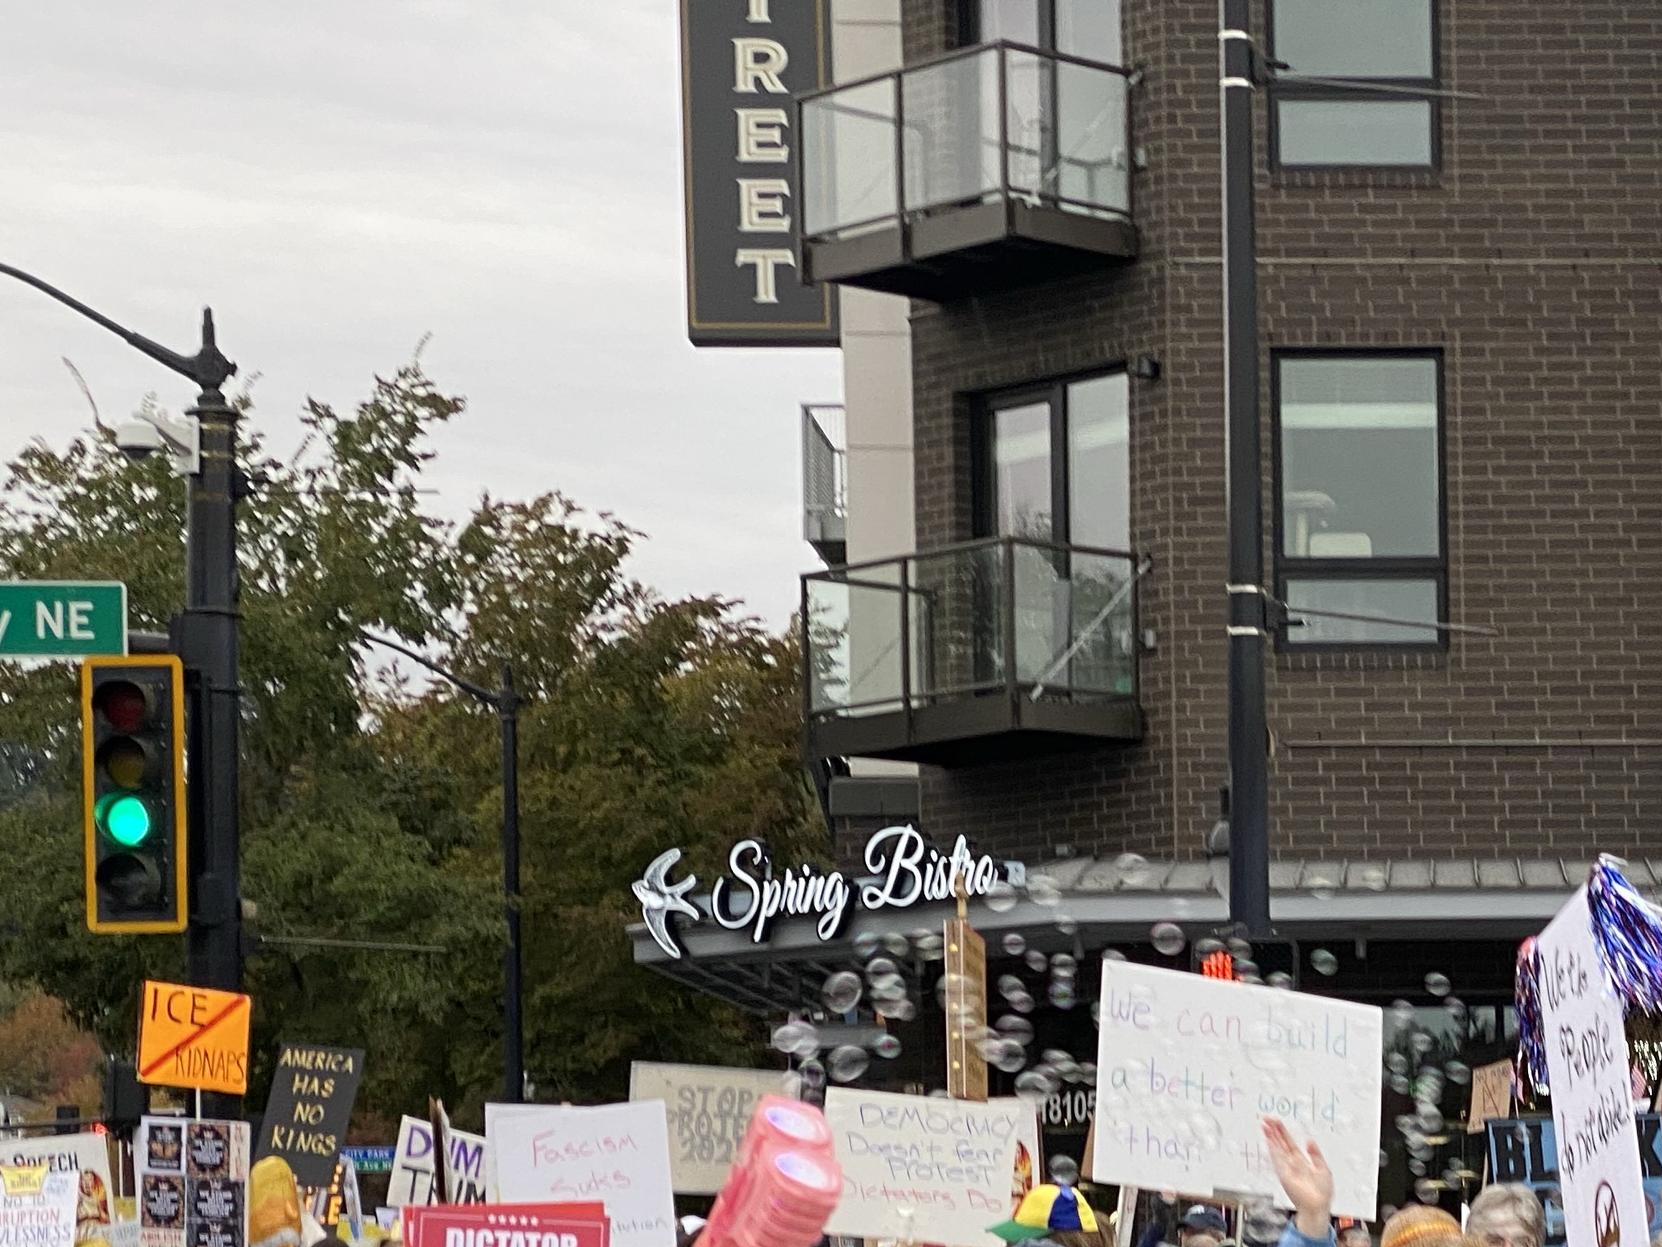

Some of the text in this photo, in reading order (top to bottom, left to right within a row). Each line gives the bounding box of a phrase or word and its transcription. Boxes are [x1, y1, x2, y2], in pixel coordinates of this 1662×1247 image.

[36, 600, 95, 640] NE
[712, 824, 998, 943] Spring Bistro
[150, 988, 210, 1028] ICE
[1266, 1009, 1348, 1057] build
[174, 1048, 247, 1084] KIDNAPS
[279, 1048, 353, 1074] AMERICA
[292, 1074, 335, 1098] HAS
[678, 1085, 754, 1119] STOP
[1111, 1057, 1339, 1124] a better world
[293, 1101, 326, 1126] NO
[859, 1102, 1018, 1145] DEMOCRACY
[271, 1125, 336, 1156] KINGS
[680, 1135, 741, 1163] 202
